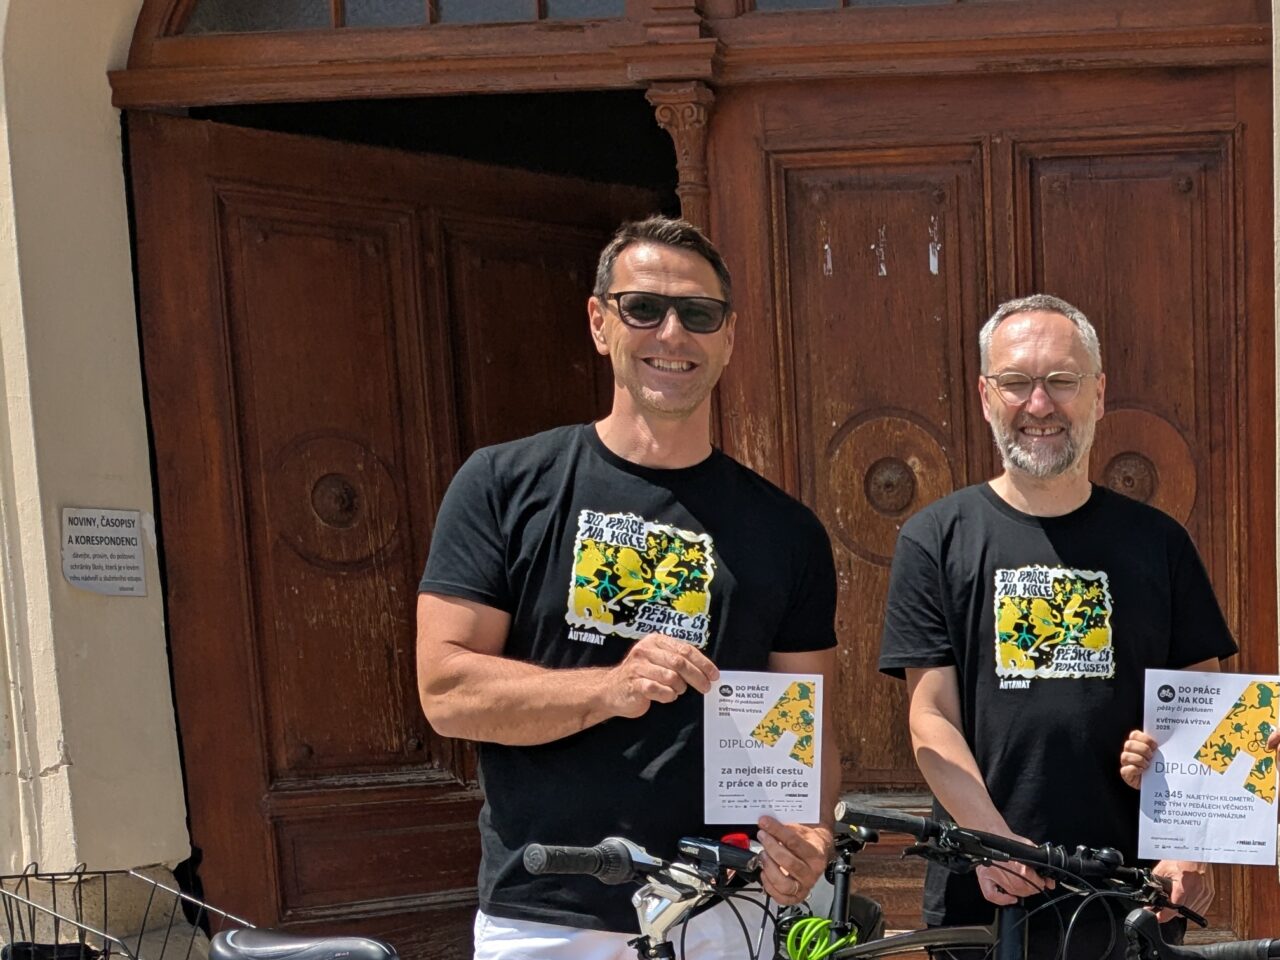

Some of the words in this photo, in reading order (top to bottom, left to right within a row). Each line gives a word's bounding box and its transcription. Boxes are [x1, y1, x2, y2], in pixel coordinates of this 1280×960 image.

[68, 517, 99, 528] NOVINY,
[101, 515, 135, 528] ČASOPISY
[68, 535, 73, 544] A
[75, 536, 137, 546] KORESPONDENCI
[747, 684, 769, 692] PRÁCE
[1178, 686, 1191, 694] DO
[1193, 685, 1221, 695] PRÁCE
[1178, 696, 1190, 704] NA
[1192, 696, 1214, 705] KOLE
[719, 739, 764, 748] DIPLOM
[735, 766, 774, 777] nejdelší
[1155, 761, 1211, 776] DIPLOM
[726, 779, 754, 789] práce
[766, 779, 778, 788] do
[781, 779, 808, 789] práce
[1164, 790, 1182, 799] 345
[1186, 793, 1219, 801] NAJETÝCH
[1168, 810, 1206, 818] STOJANOVO
[1208, 811, 1246, 819] GYMNÁZIUM
[1174, 818, 1201, 826] PLANETU
